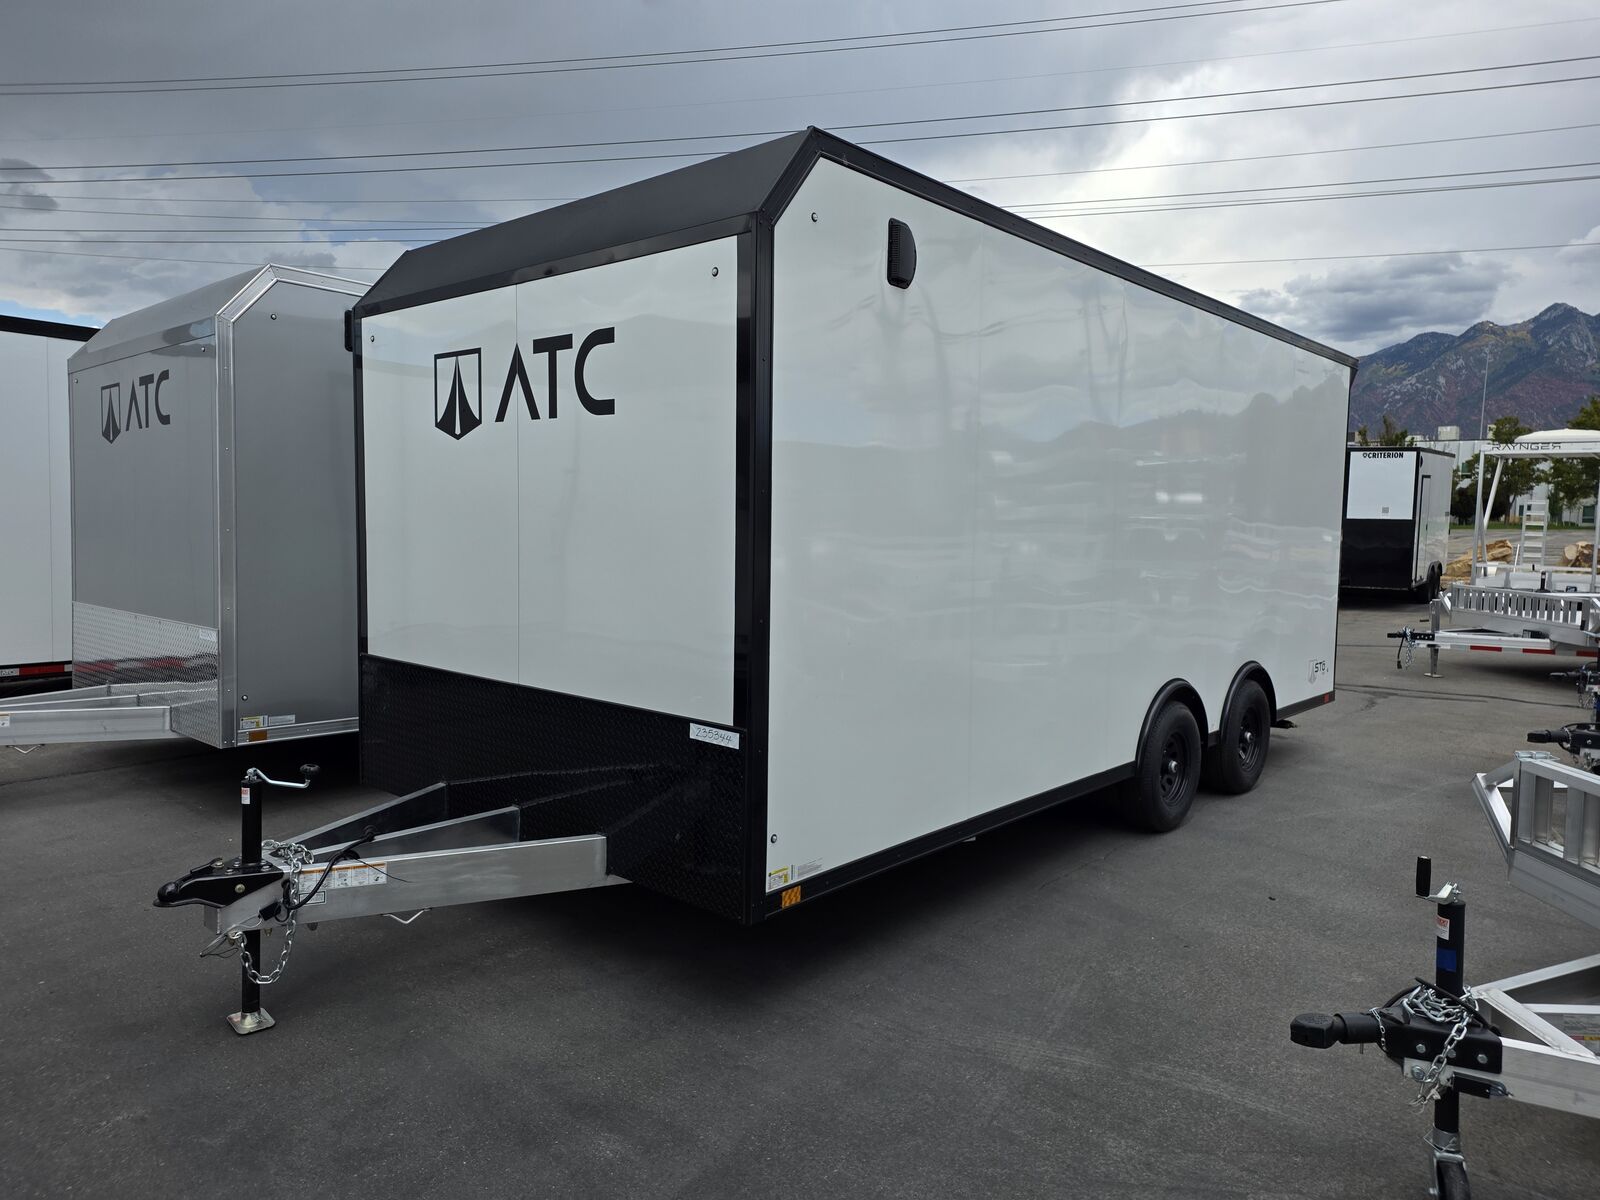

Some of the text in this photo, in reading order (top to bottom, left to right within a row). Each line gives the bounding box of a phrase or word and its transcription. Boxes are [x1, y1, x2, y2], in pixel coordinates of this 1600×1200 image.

[125, 369, 171, 432] ATC
[495, 327, 615, 422] ATC
[695, 727, 732, 744] 235344
